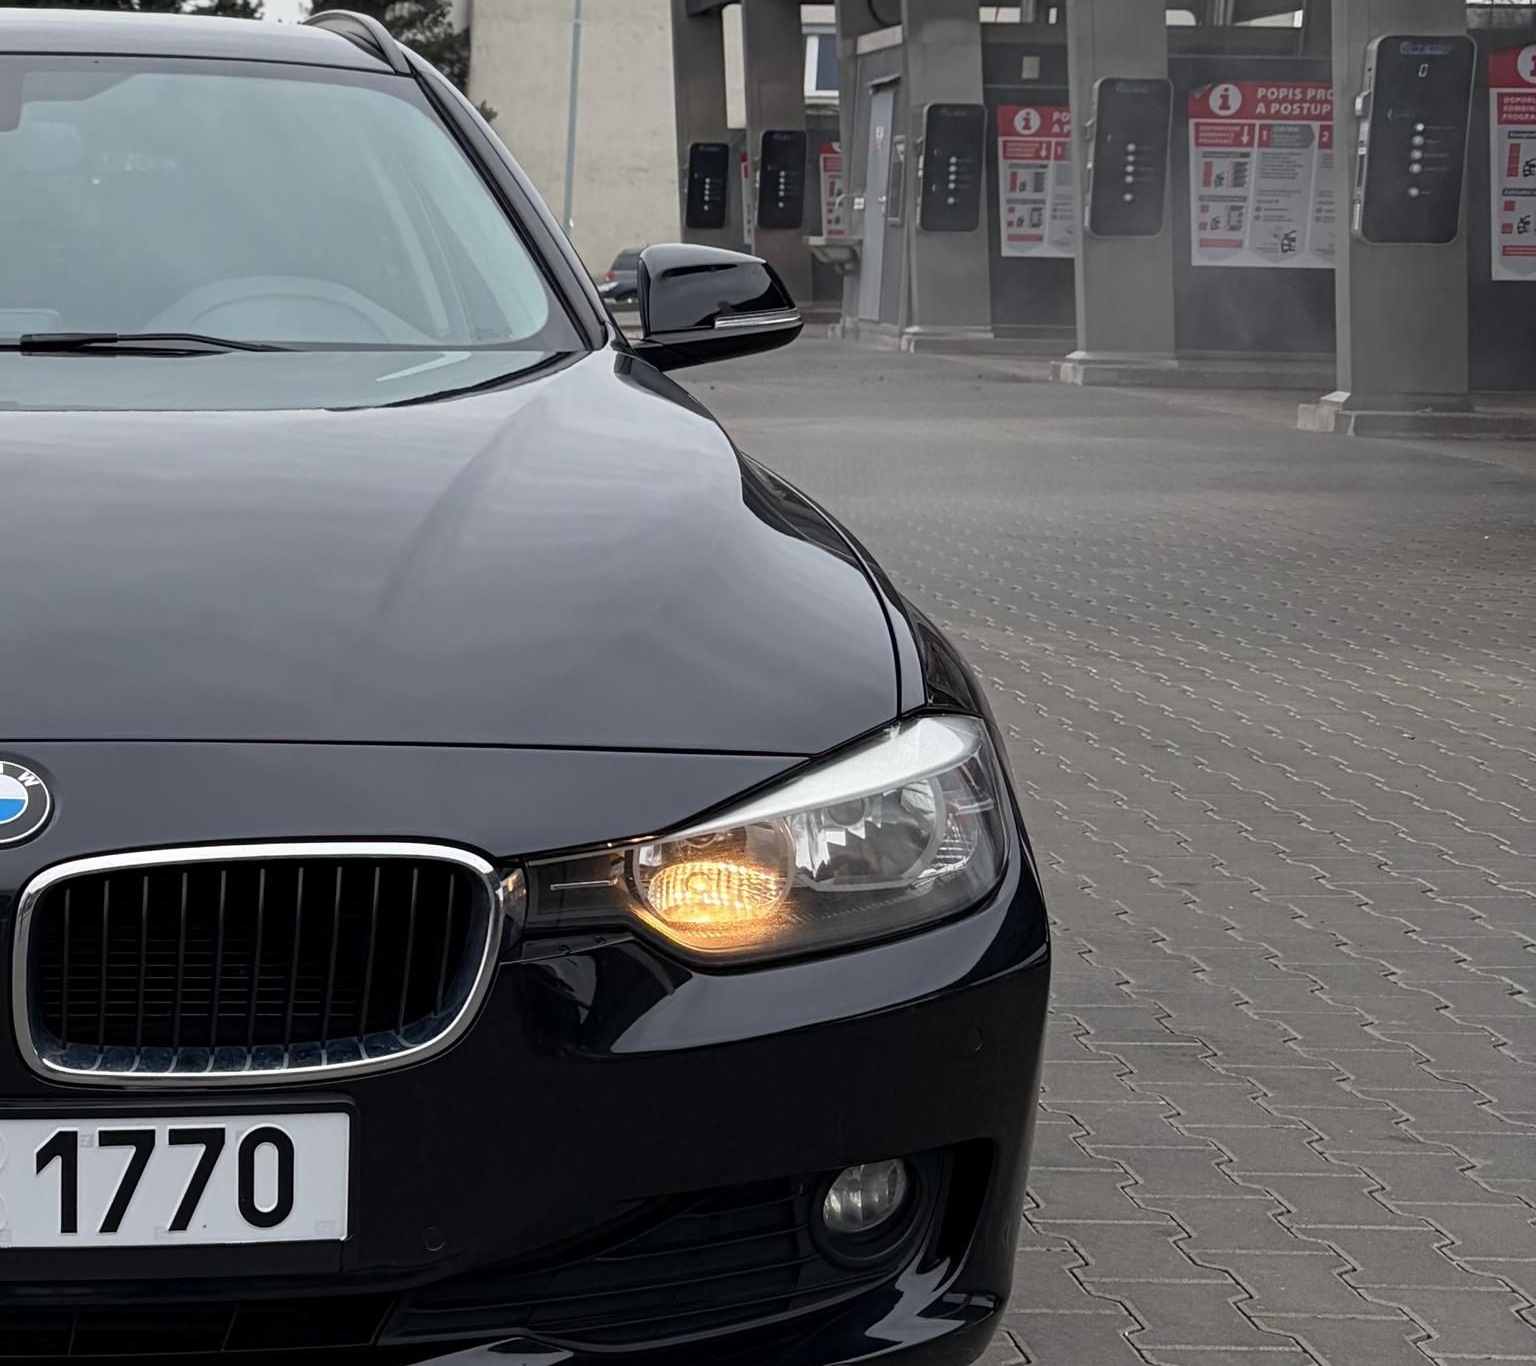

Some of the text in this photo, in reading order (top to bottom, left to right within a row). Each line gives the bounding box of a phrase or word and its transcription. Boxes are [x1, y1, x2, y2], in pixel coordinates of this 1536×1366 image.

[1257, 87, 1302, 100] POPIS
[1255, 103, 1331, 115] A POSTUP
[1321, 131, 1329, 142] 2
[35, 1124, 295, 1234] 1770
